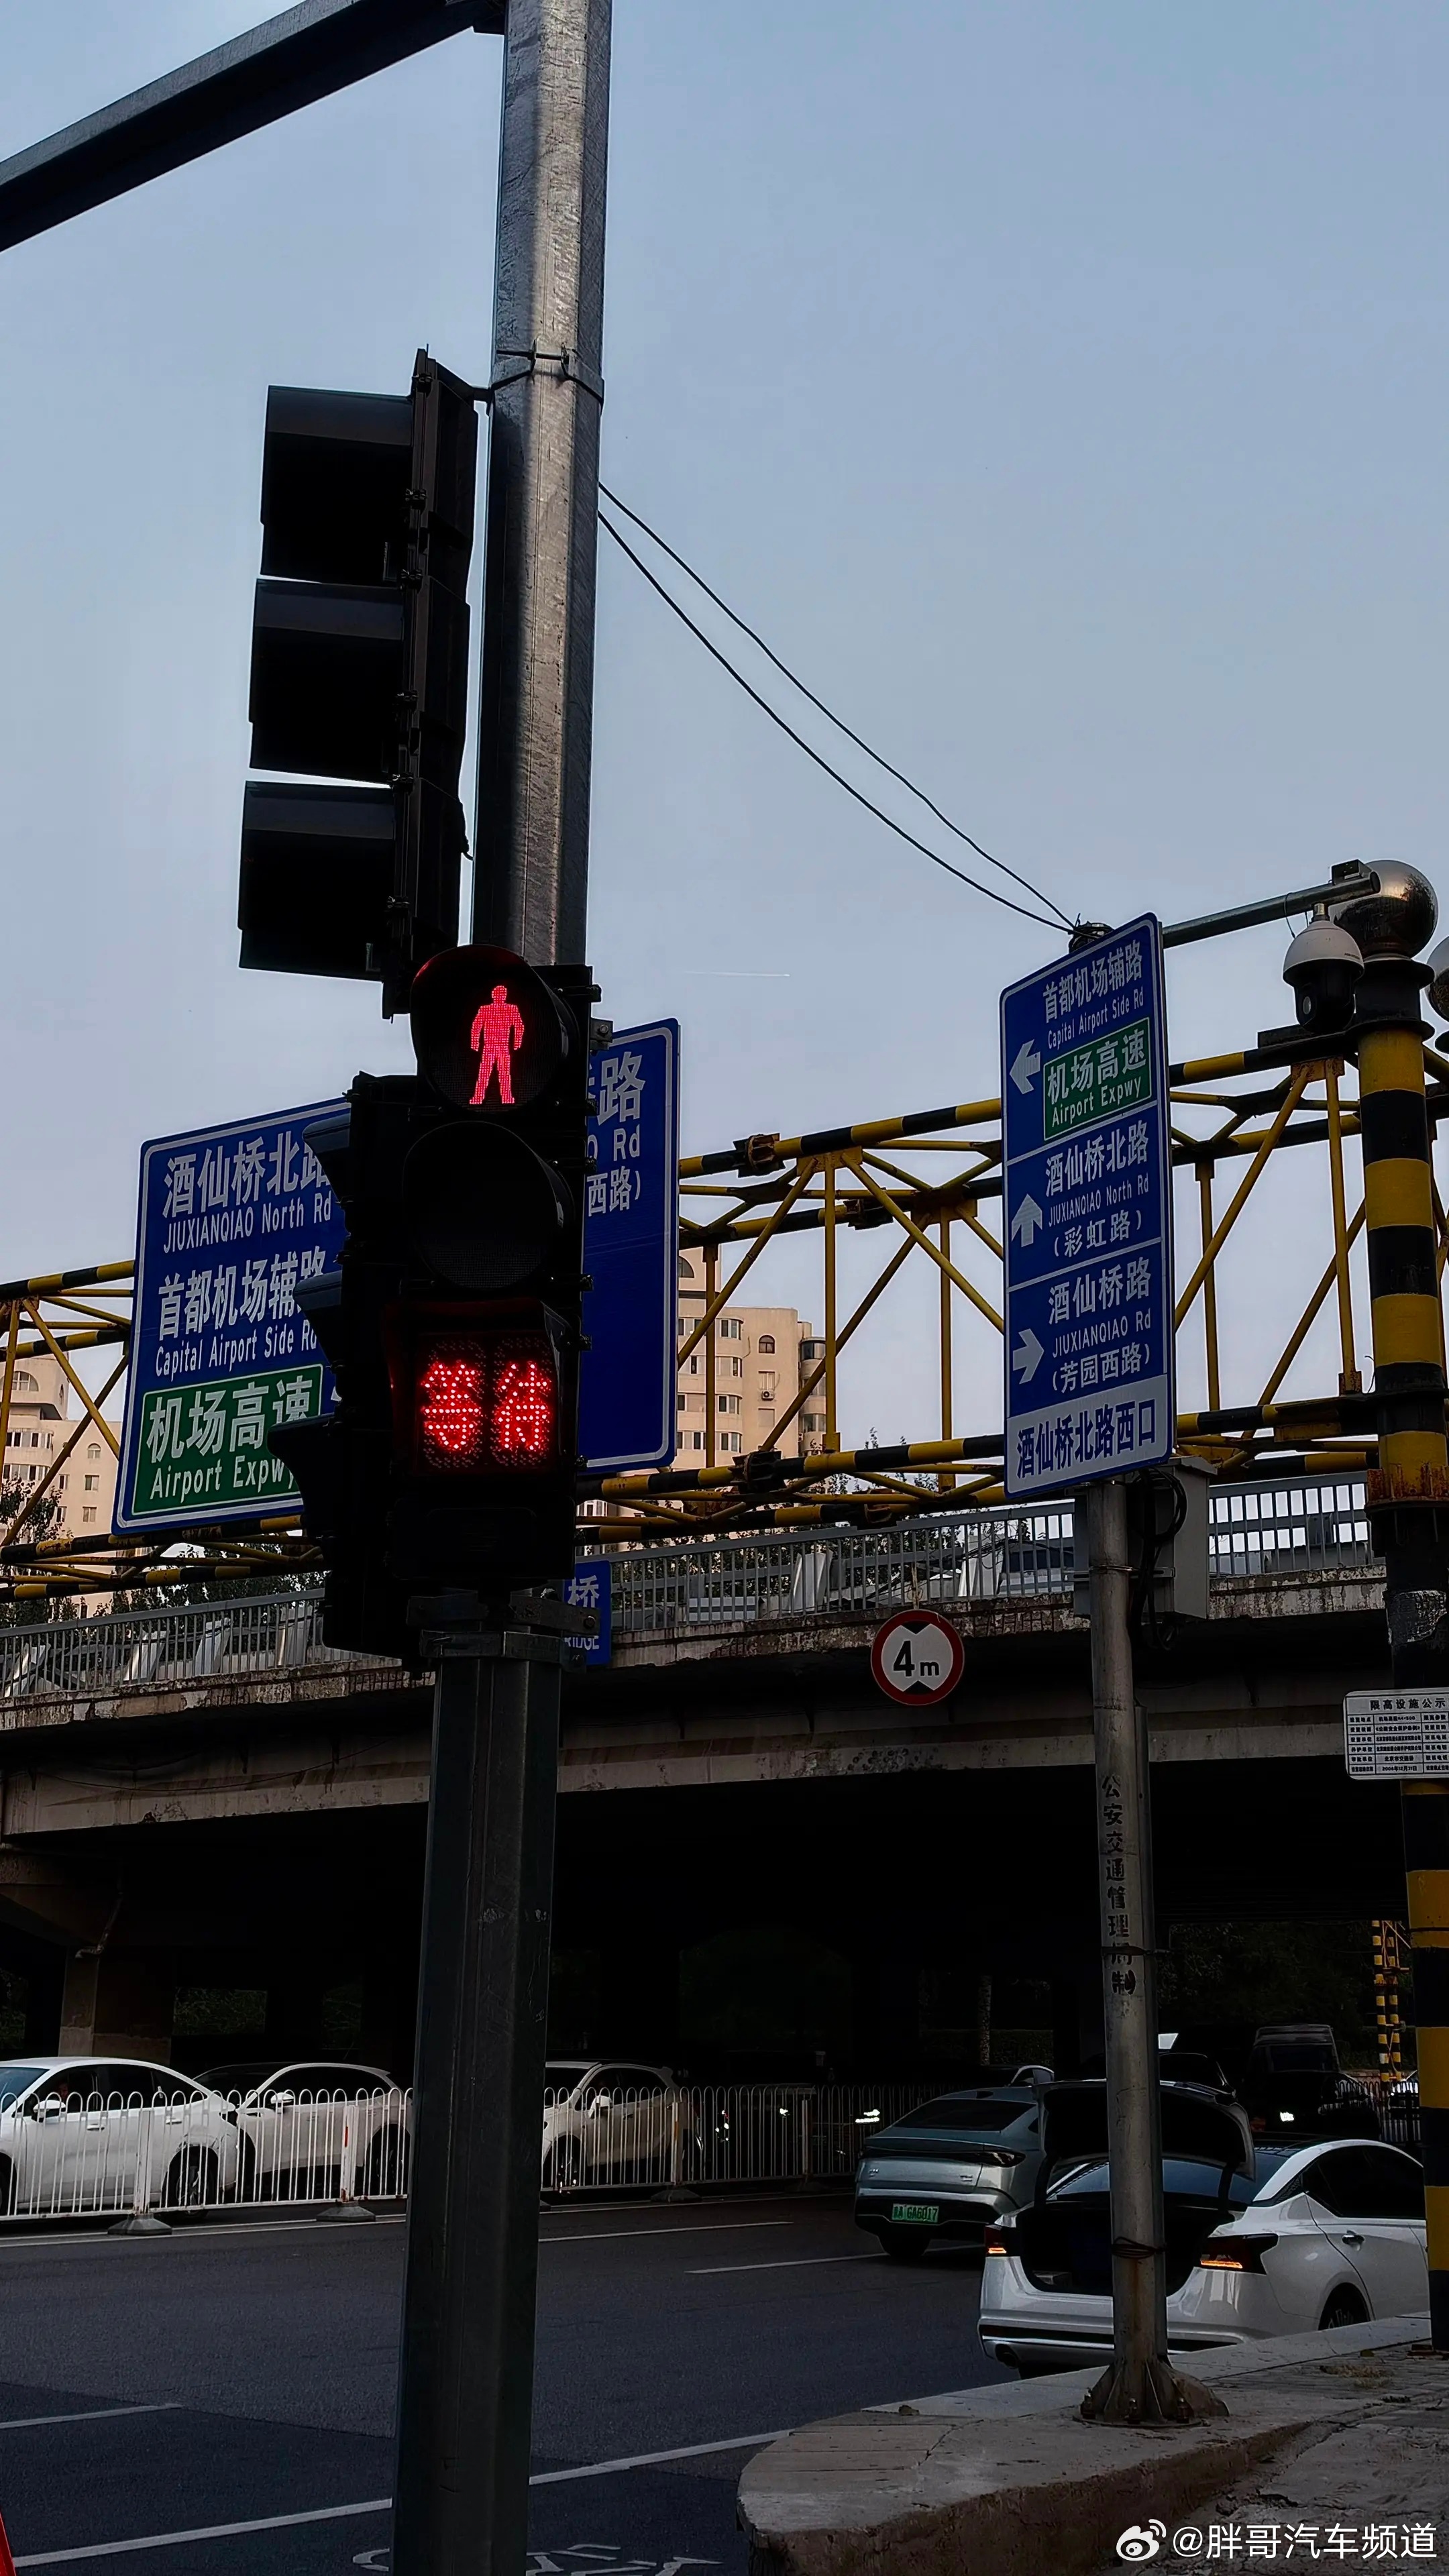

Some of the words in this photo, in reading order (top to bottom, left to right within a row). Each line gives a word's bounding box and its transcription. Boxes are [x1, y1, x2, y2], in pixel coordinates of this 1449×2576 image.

[1043, 939, 1143, 1024] 首都机场辅路
[1048, 1019, 1075, 1050] Capital
[1079, 1008, 1108, 1036] Airport
[1112, 997, 1130, 1019] Side
[1134, 987, 1144, 1008] Rd
[588, 1051, 645, 1126] 路
[1047, 1028, 1146, 1105] 机场高速
[1052, 1092, 1094, 1128] Airport
[1101, 1076, 1141, 1107] Expwy
[613, 1124, 640, 1161] Rd
[1046, 1120, 1148, 1197] 酒仙桥北路
[164, 1205, 253, 1253] JIUXIANQIAO
[262, 1204, 304, 1236] North
[314, 1191, 331, 1222] Rd
[1049, 1189, 1102, 1228] JIUXIANQIAO
[1106, 1179, 1132, 1206] North
[1138, 1173, 1148, 1195] Rd
[1055, 1210, 1141, 1257] (彩虹路)
[1048, 1256, 1151, 1325] 酒仙桥路
[156, 1344, 201, 1382] Capital
[209, 1333, 257, 1372] Airport
[265, 1324, 293, 1357] Side
[1053, 1316, 1128, 1358] JIUXIANQIAO
[1136, 1308, 1151, 1331] Rd
[1053, 1342, 1150, 1393] (芳园西路)
[146, 1375, 311, 1464] 机场高速
[423, 1362, 549, 1451] 等待
[1017, 1399, 1156, 1479] 酒仙桥北路西口
[150, 1461, 222, 1503] Airport
[568, 1575, 599, 1608] 桥
[1370, 1698, 1449, 1711] 限高设施公示
